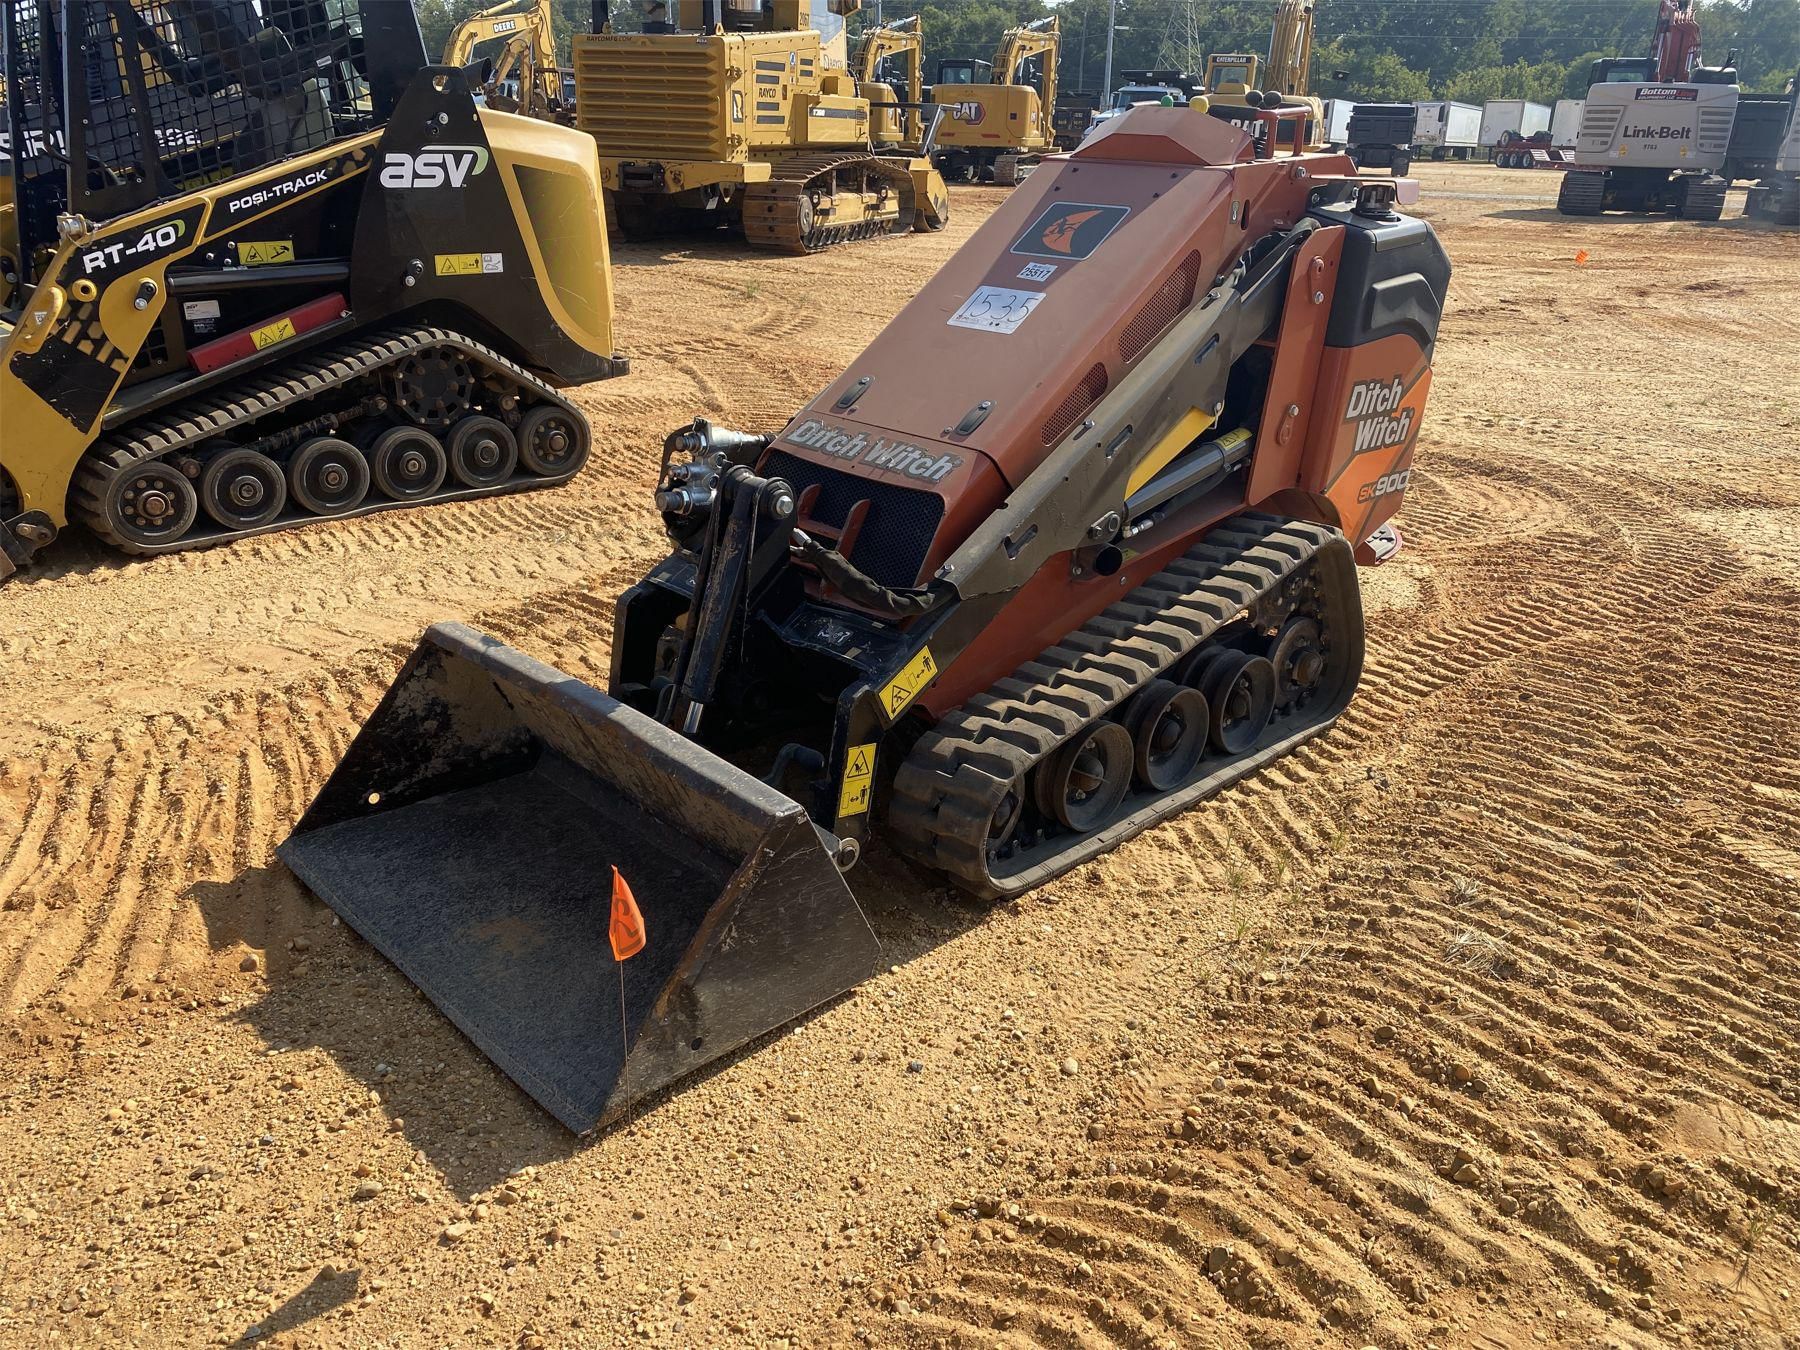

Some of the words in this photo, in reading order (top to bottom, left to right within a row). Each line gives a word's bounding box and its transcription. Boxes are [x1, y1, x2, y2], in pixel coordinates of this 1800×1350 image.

[493, 20, 516, 33] DEERE
[758, 87, 777, 98] RAYCO
[952, 102, 979, 121] CAT
[1622, 125, 1692, 140] Link-Belt
[229, 169, 328, 213] POSI-TRACK
[82, 226, 176, 274] RT-40
[1020, 267, 1051, 278] 25517
[959, 291, 1040, 322] 1535
[1345, 378, 1403, 419] Ditch
[1354, 411, 1411, 452] Witch
[786, 419, 868, 459] Ditch
[863, 437, 954, 481] Witch
[1357, 469, 1410, 502] SK900
